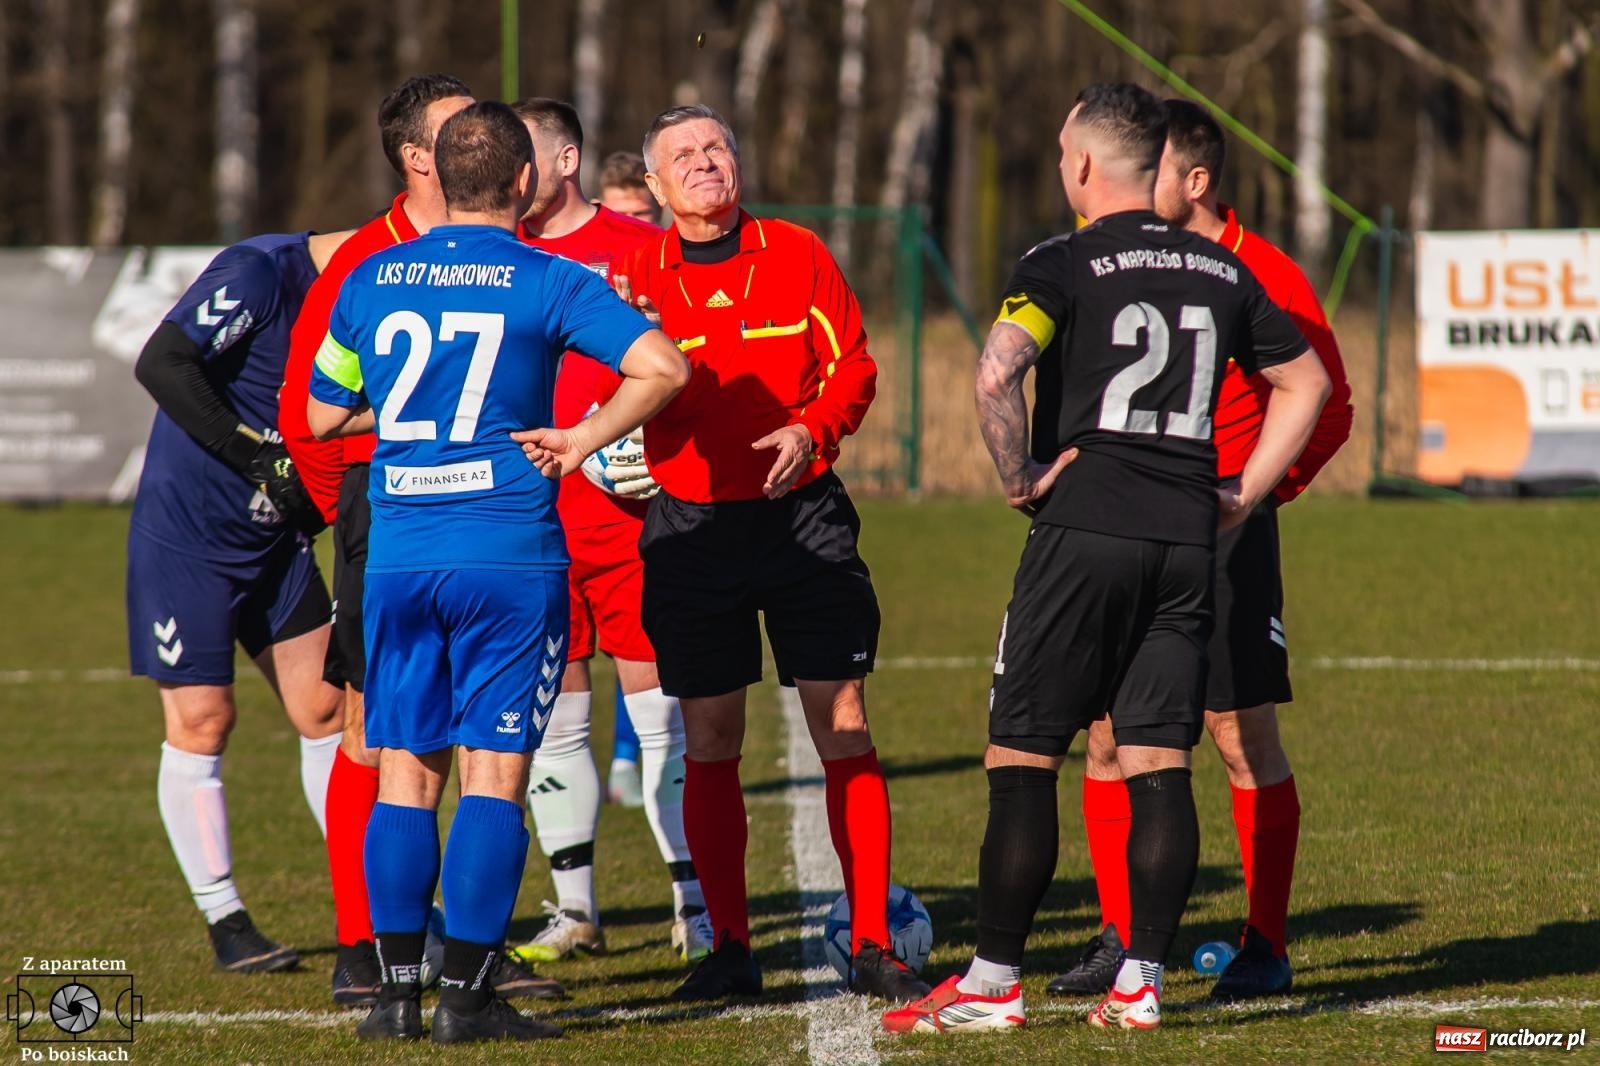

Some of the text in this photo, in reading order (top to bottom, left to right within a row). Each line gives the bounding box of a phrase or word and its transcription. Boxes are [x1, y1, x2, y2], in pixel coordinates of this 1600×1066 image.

[376, 262, 516, 288] LKS 07 MARKOWICE
[1089, 248, 1239, 285] KS NAPRZÓD BORUCIN
[1448, 319, 1600, 347] BRUKA
[374, 310, 505, 442] 27
[1097, 301, 1218, 440] 21
[412, 470, 488, 486] FINANSE AZ
